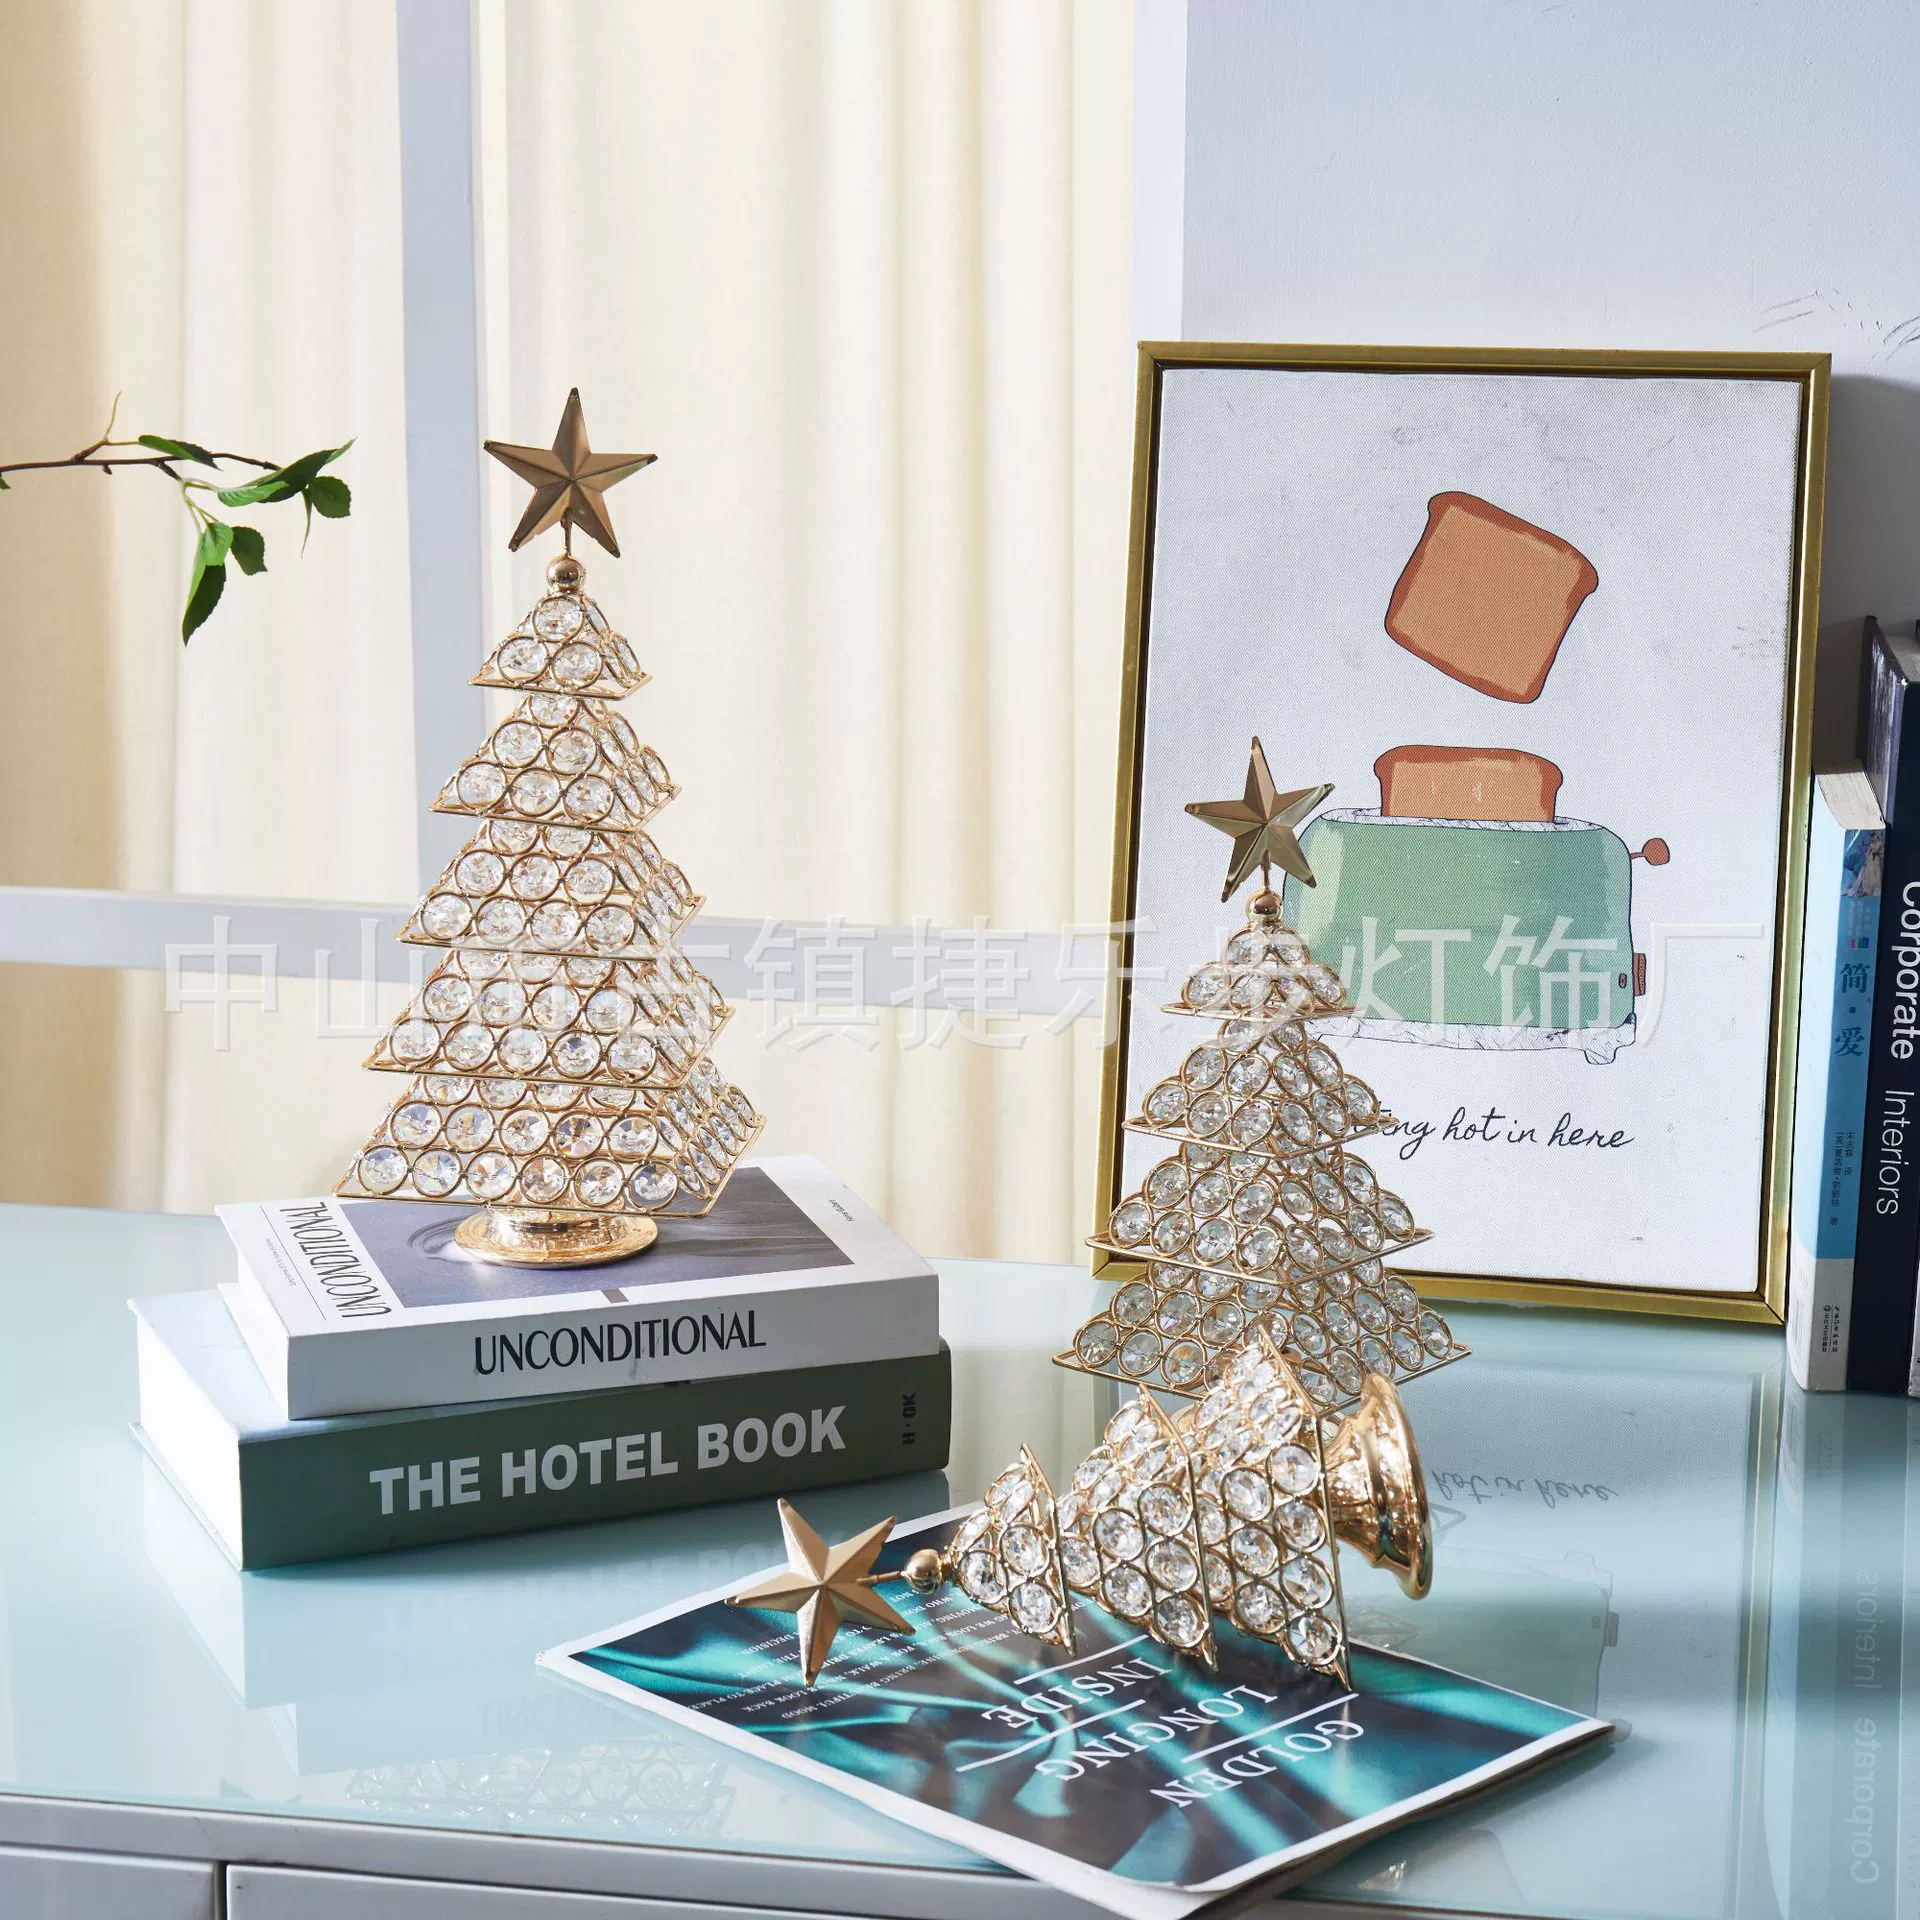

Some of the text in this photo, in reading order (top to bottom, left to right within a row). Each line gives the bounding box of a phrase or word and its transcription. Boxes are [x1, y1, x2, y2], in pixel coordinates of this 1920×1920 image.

[1876, 881, 1920, 1215] Corporate Interiors
[1442, 1106, 1505, 1141] hot
[1507, 1120, 1537, 1143] in
[1548, 1112, 1635, 1148] here
[279, 1200, 392, 1319] UNCONDITIONAL
[473, 1309, 766, 1375] UNCONDITIONAL
[369, 1406, 846, 1516] THE HOTEL BOOK
[981, 1658, 1173, 1729] INSIDE
[1034, 1684, 1278, 1781] LONGING
[1150, 1719, 1364, 1809] GOLDEN
